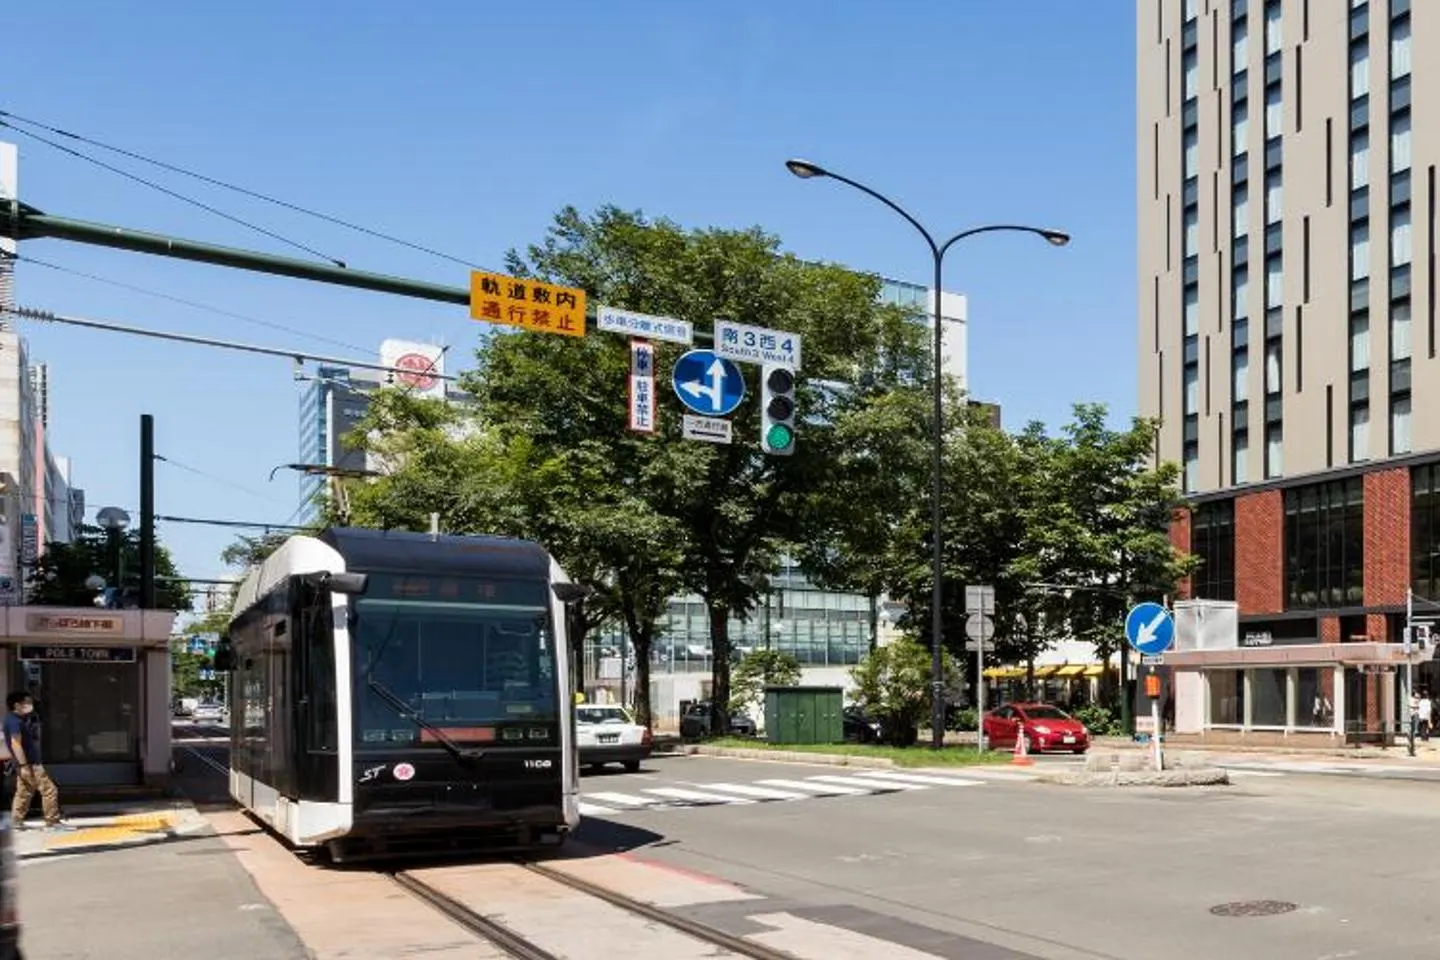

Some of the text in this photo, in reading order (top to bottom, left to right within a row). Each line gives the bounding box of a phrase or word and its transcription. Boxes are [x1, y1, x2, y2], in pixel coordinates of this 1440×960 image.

[481, 277, 577, 310] 軌道敷内
[481, 300, 579, 331] 通行禁止
